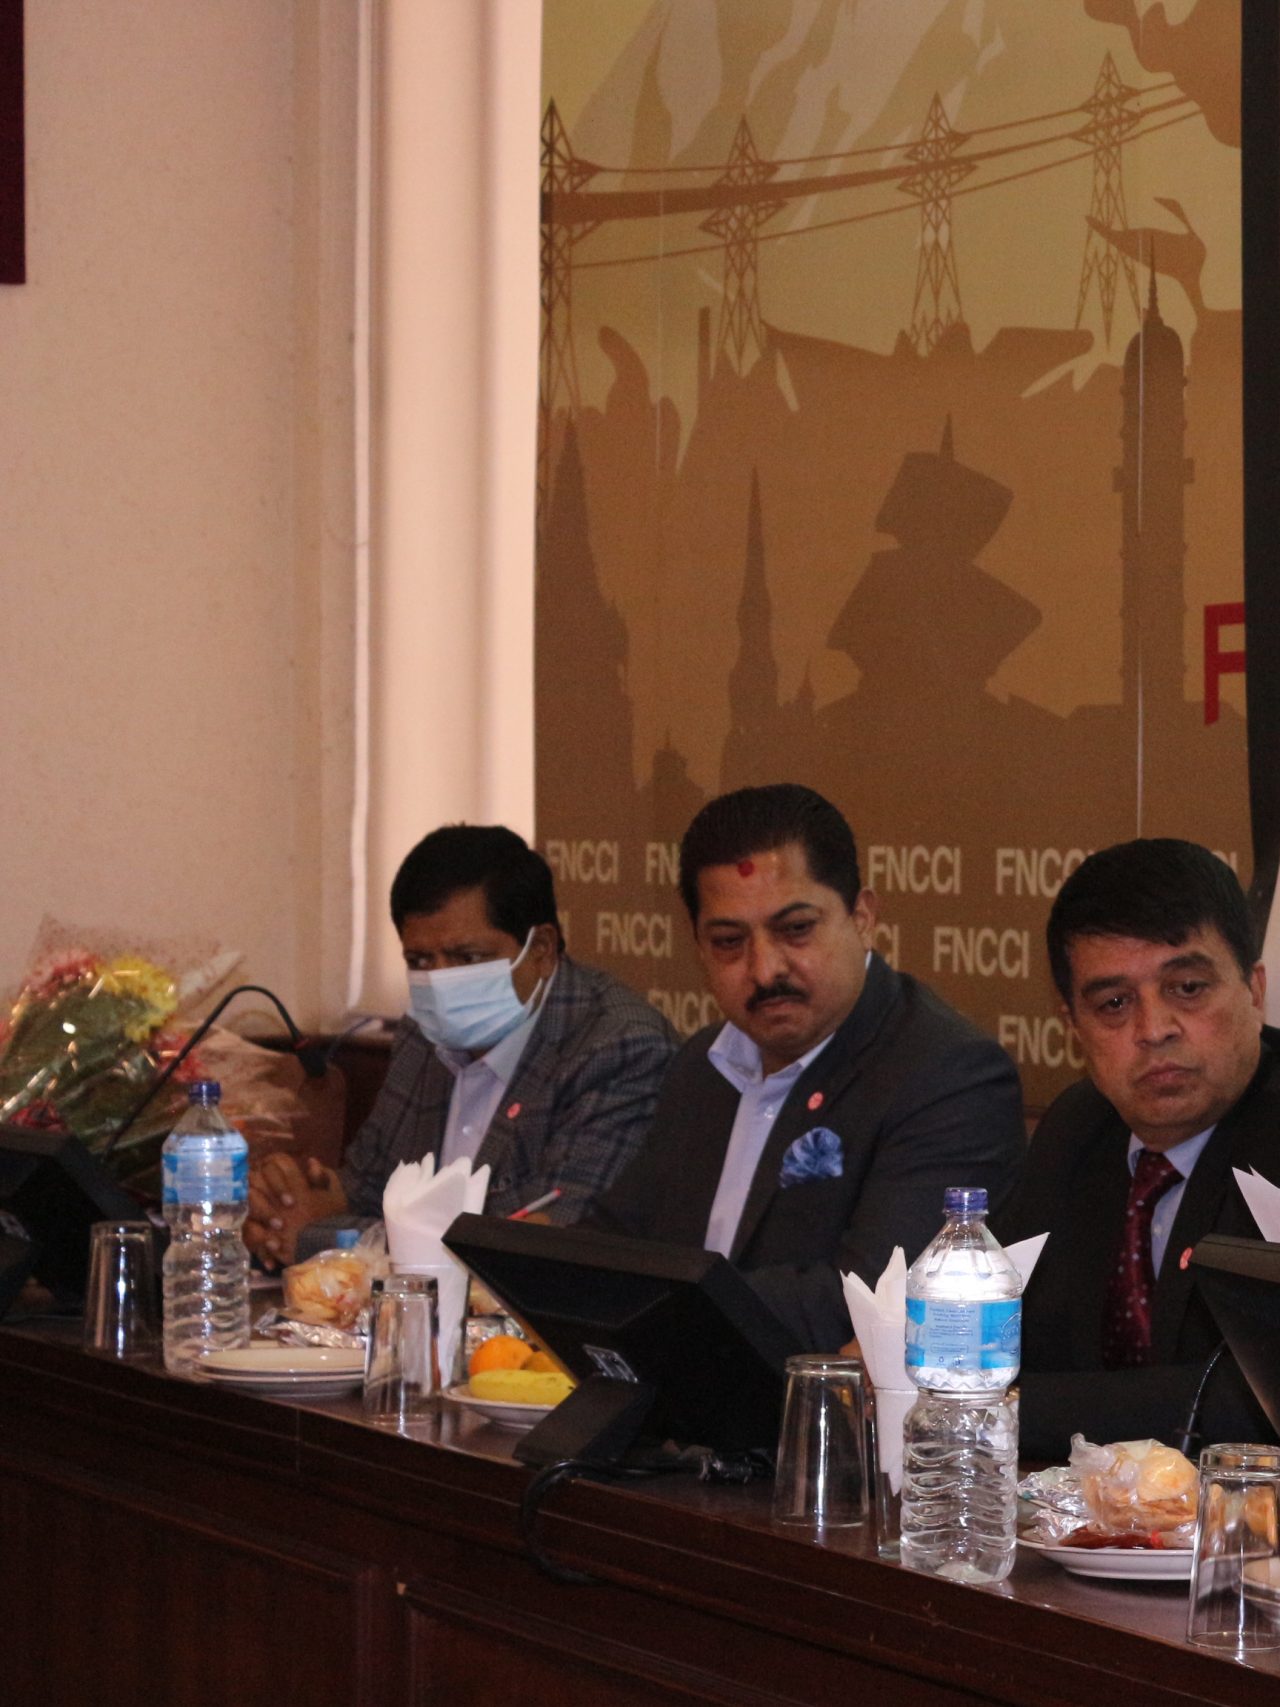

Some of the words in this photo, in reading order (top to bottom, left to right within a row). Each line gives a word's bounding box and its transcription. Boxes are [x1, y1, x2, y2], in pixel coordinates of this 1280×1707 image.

[545, 840, 619, 884] FNCCI
[867, 845, 961, 895] FNCCI
[596, 911, 672, 958] FNCCI
[932, 926, 1030, 979] FNCCI
[998, 1015, 1086, 1069] FNCC
